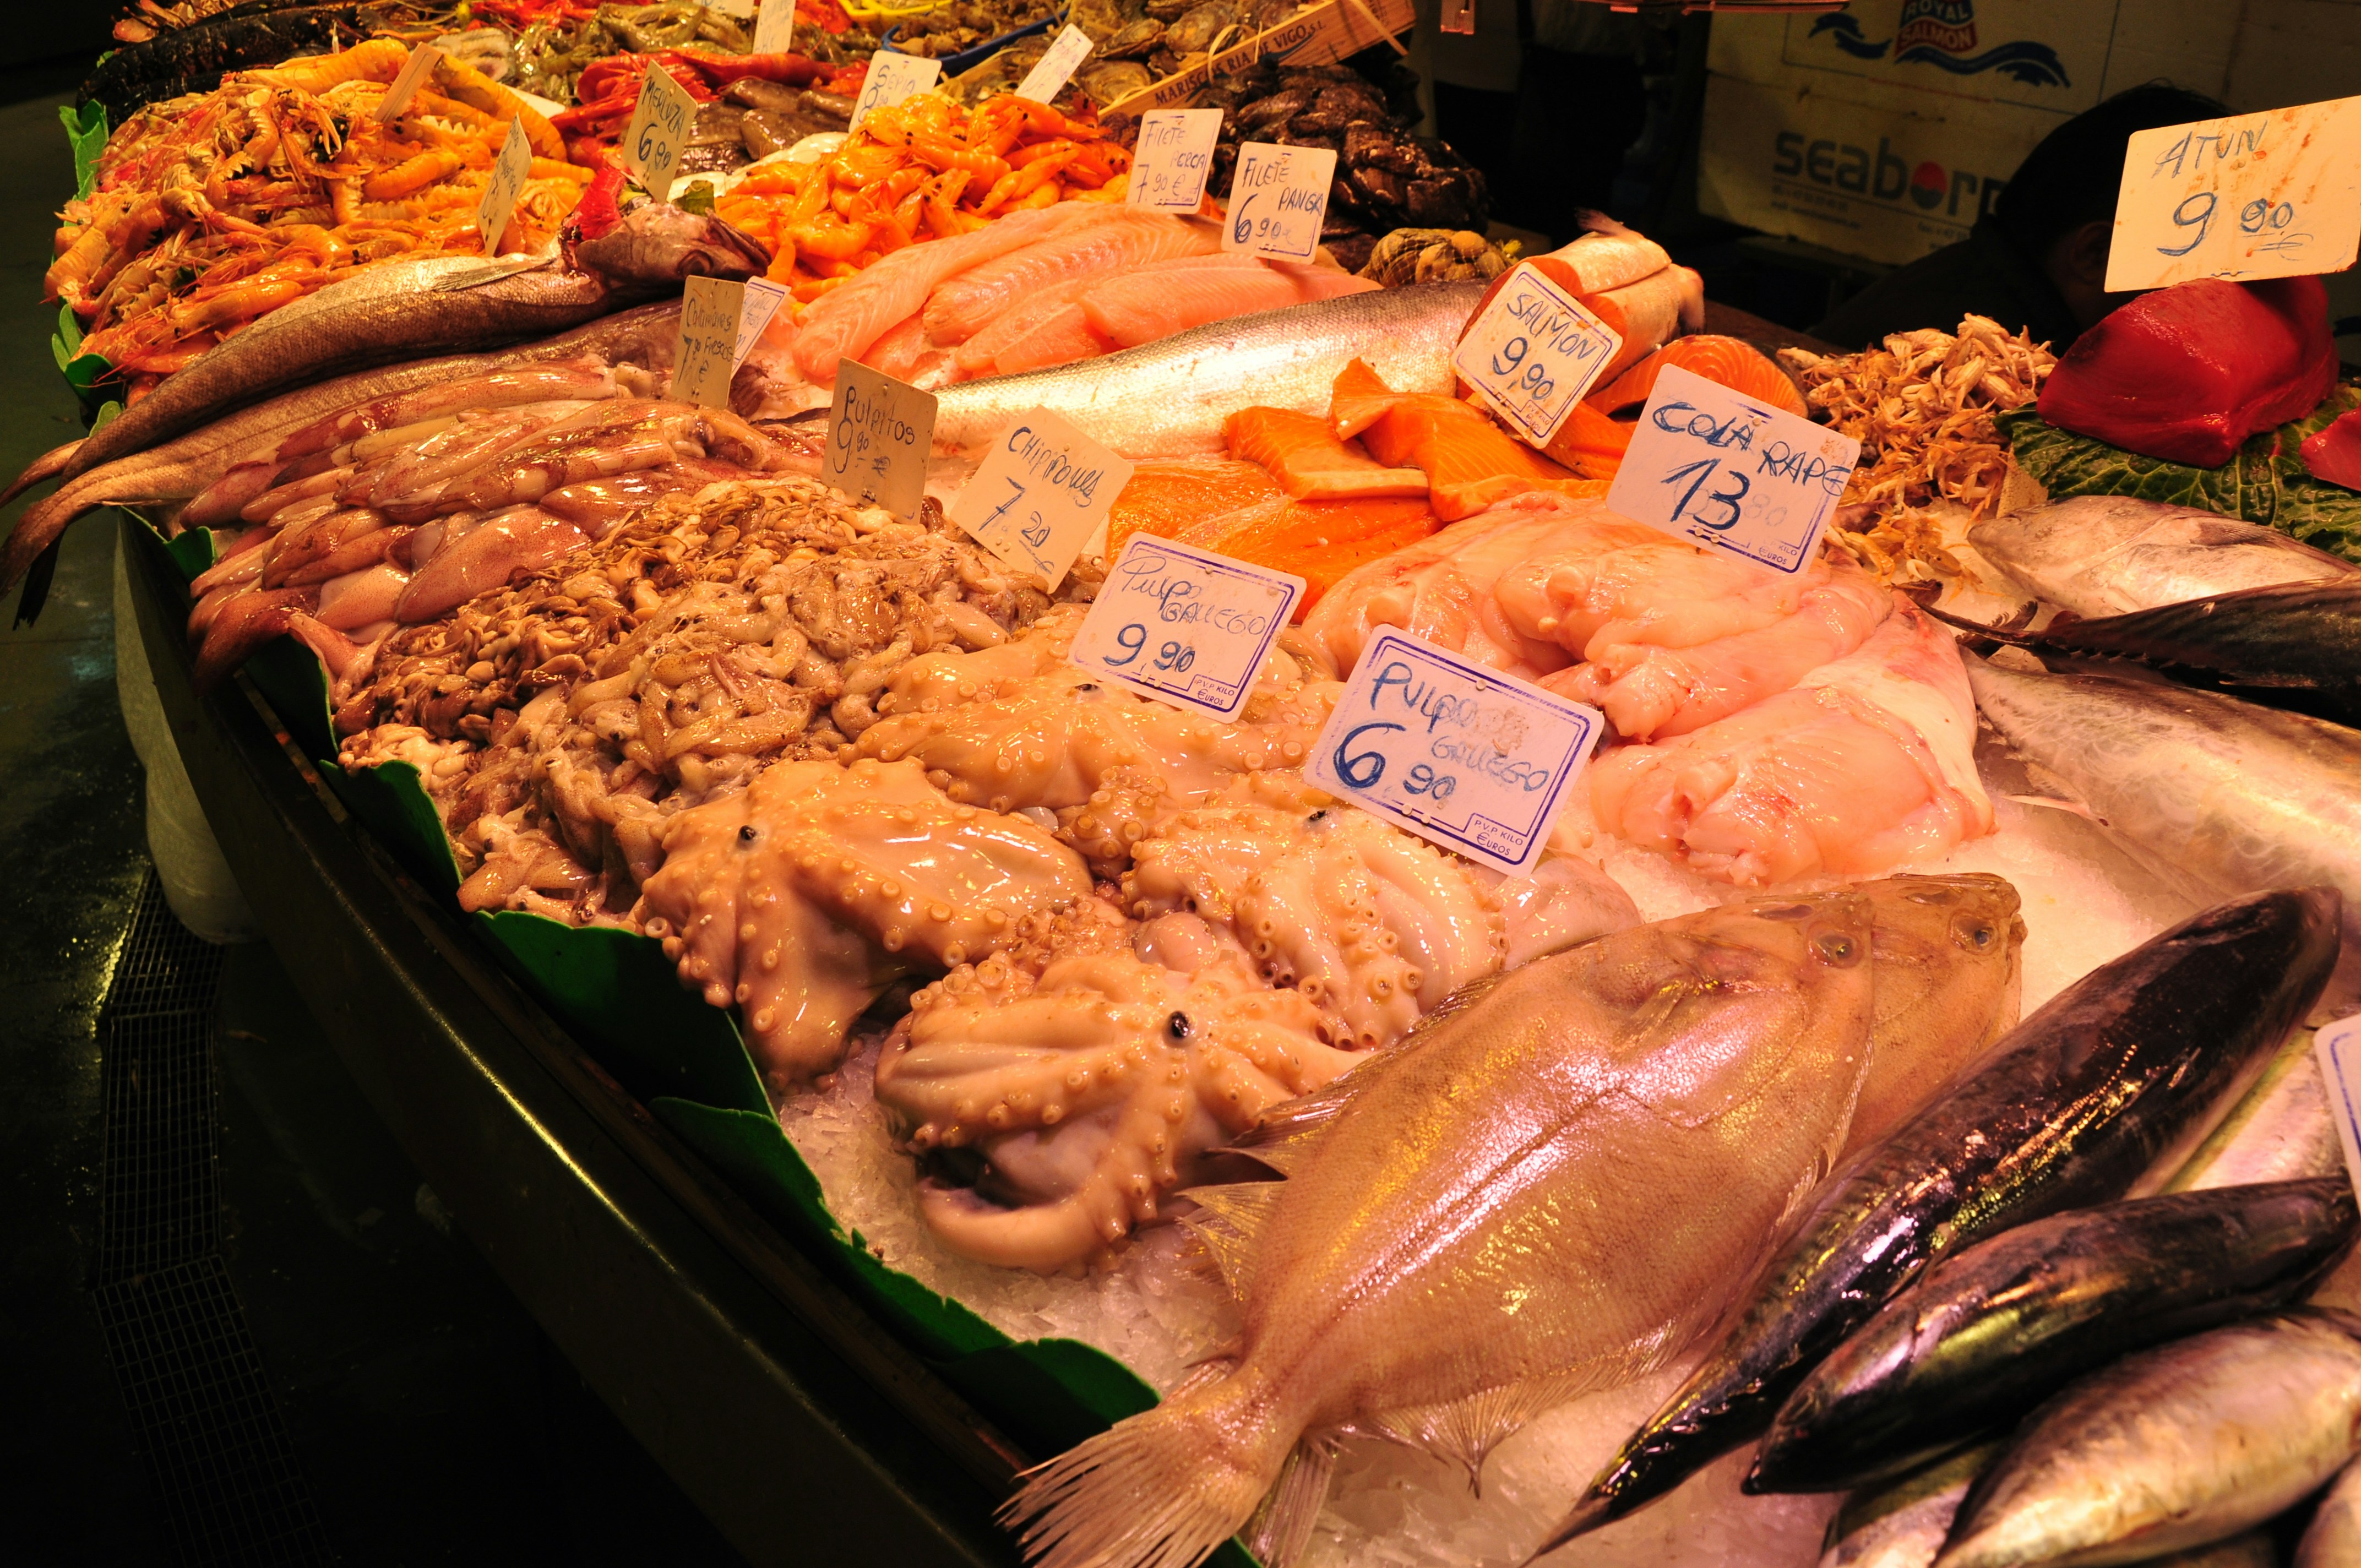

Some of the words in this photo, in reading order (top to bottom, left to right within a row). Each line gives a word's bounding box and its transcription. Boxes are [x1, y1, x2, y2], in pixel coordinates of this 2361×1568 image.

[1227, 52, 1251, 70] RIA
[2151, 119, 2267, 178] ATUN
[1778, 545, 1797, 556] KILO
[1216, 686, 1234, 696] KILO
[1500, 831, 1524, 845] KILO
